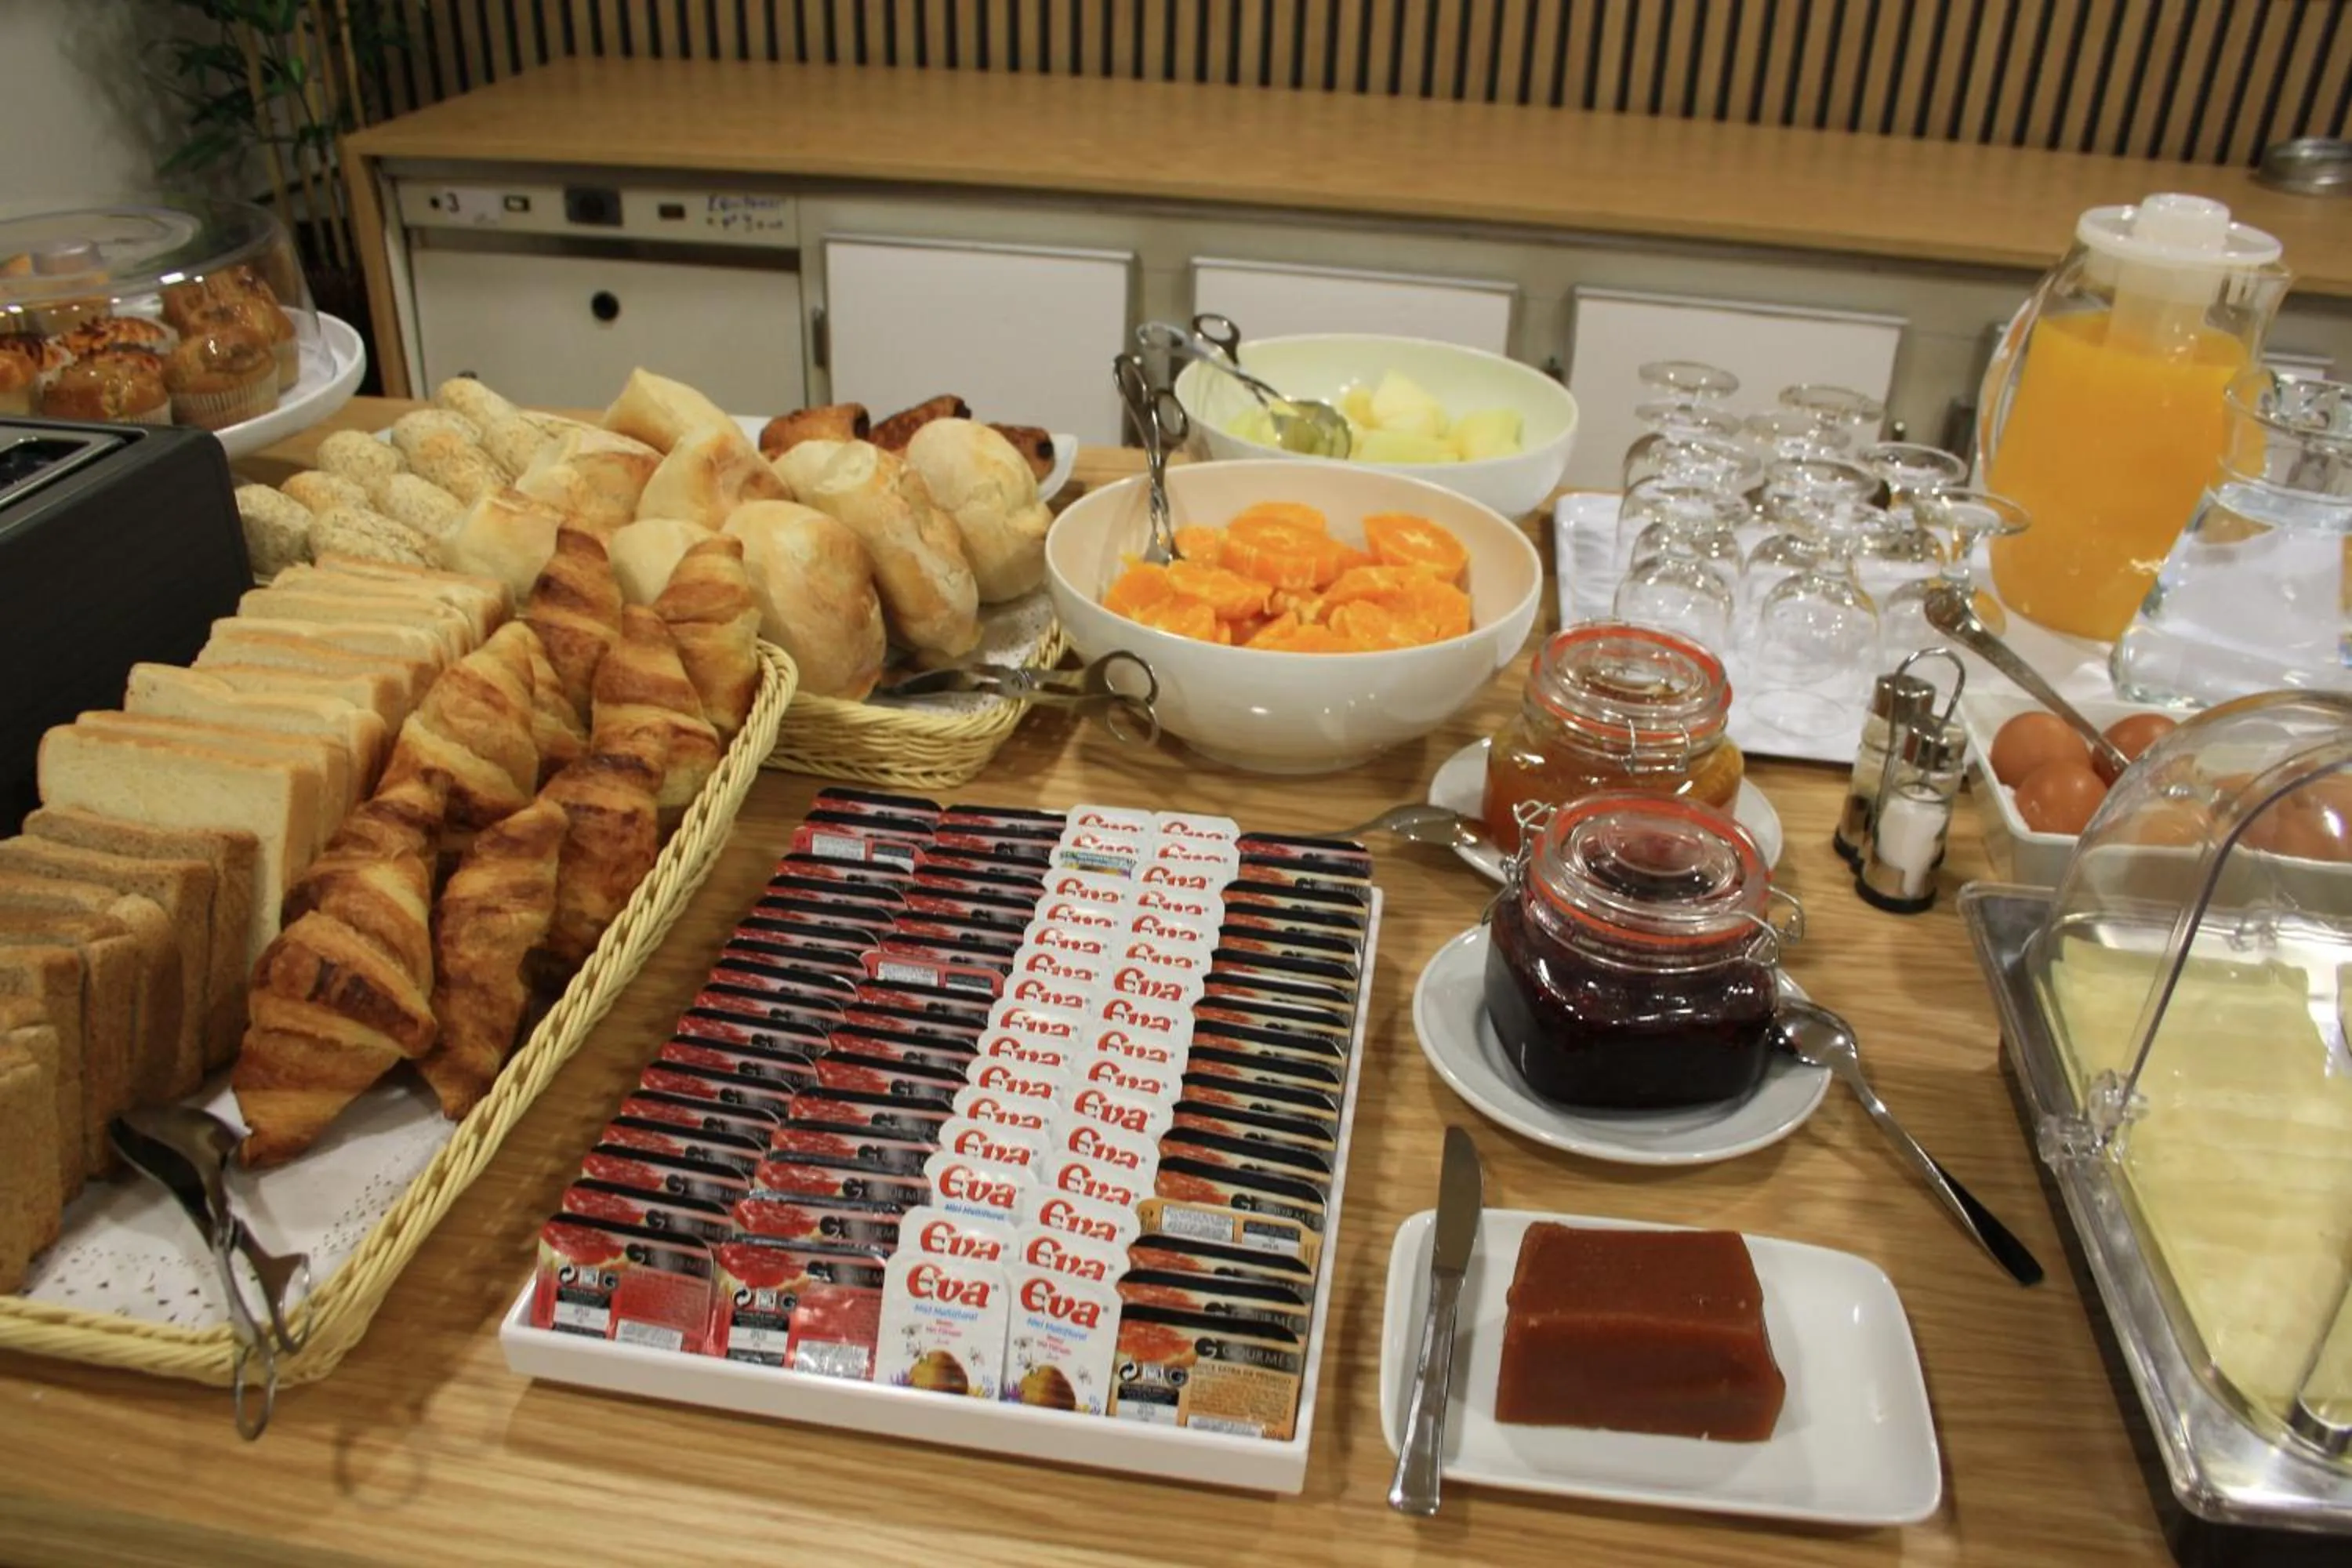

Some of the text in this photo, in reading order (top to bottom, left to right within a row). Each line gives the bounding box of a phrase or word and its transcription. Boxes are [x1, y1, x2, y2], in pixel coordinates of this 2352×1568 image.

[1073, 1089, 1149, 1133] Eva
[938, 1163, 1016, 1209] Eva
[906, 1263, 991, 1309] Eva
[1020, 1277, 1102, 1330] Eva
